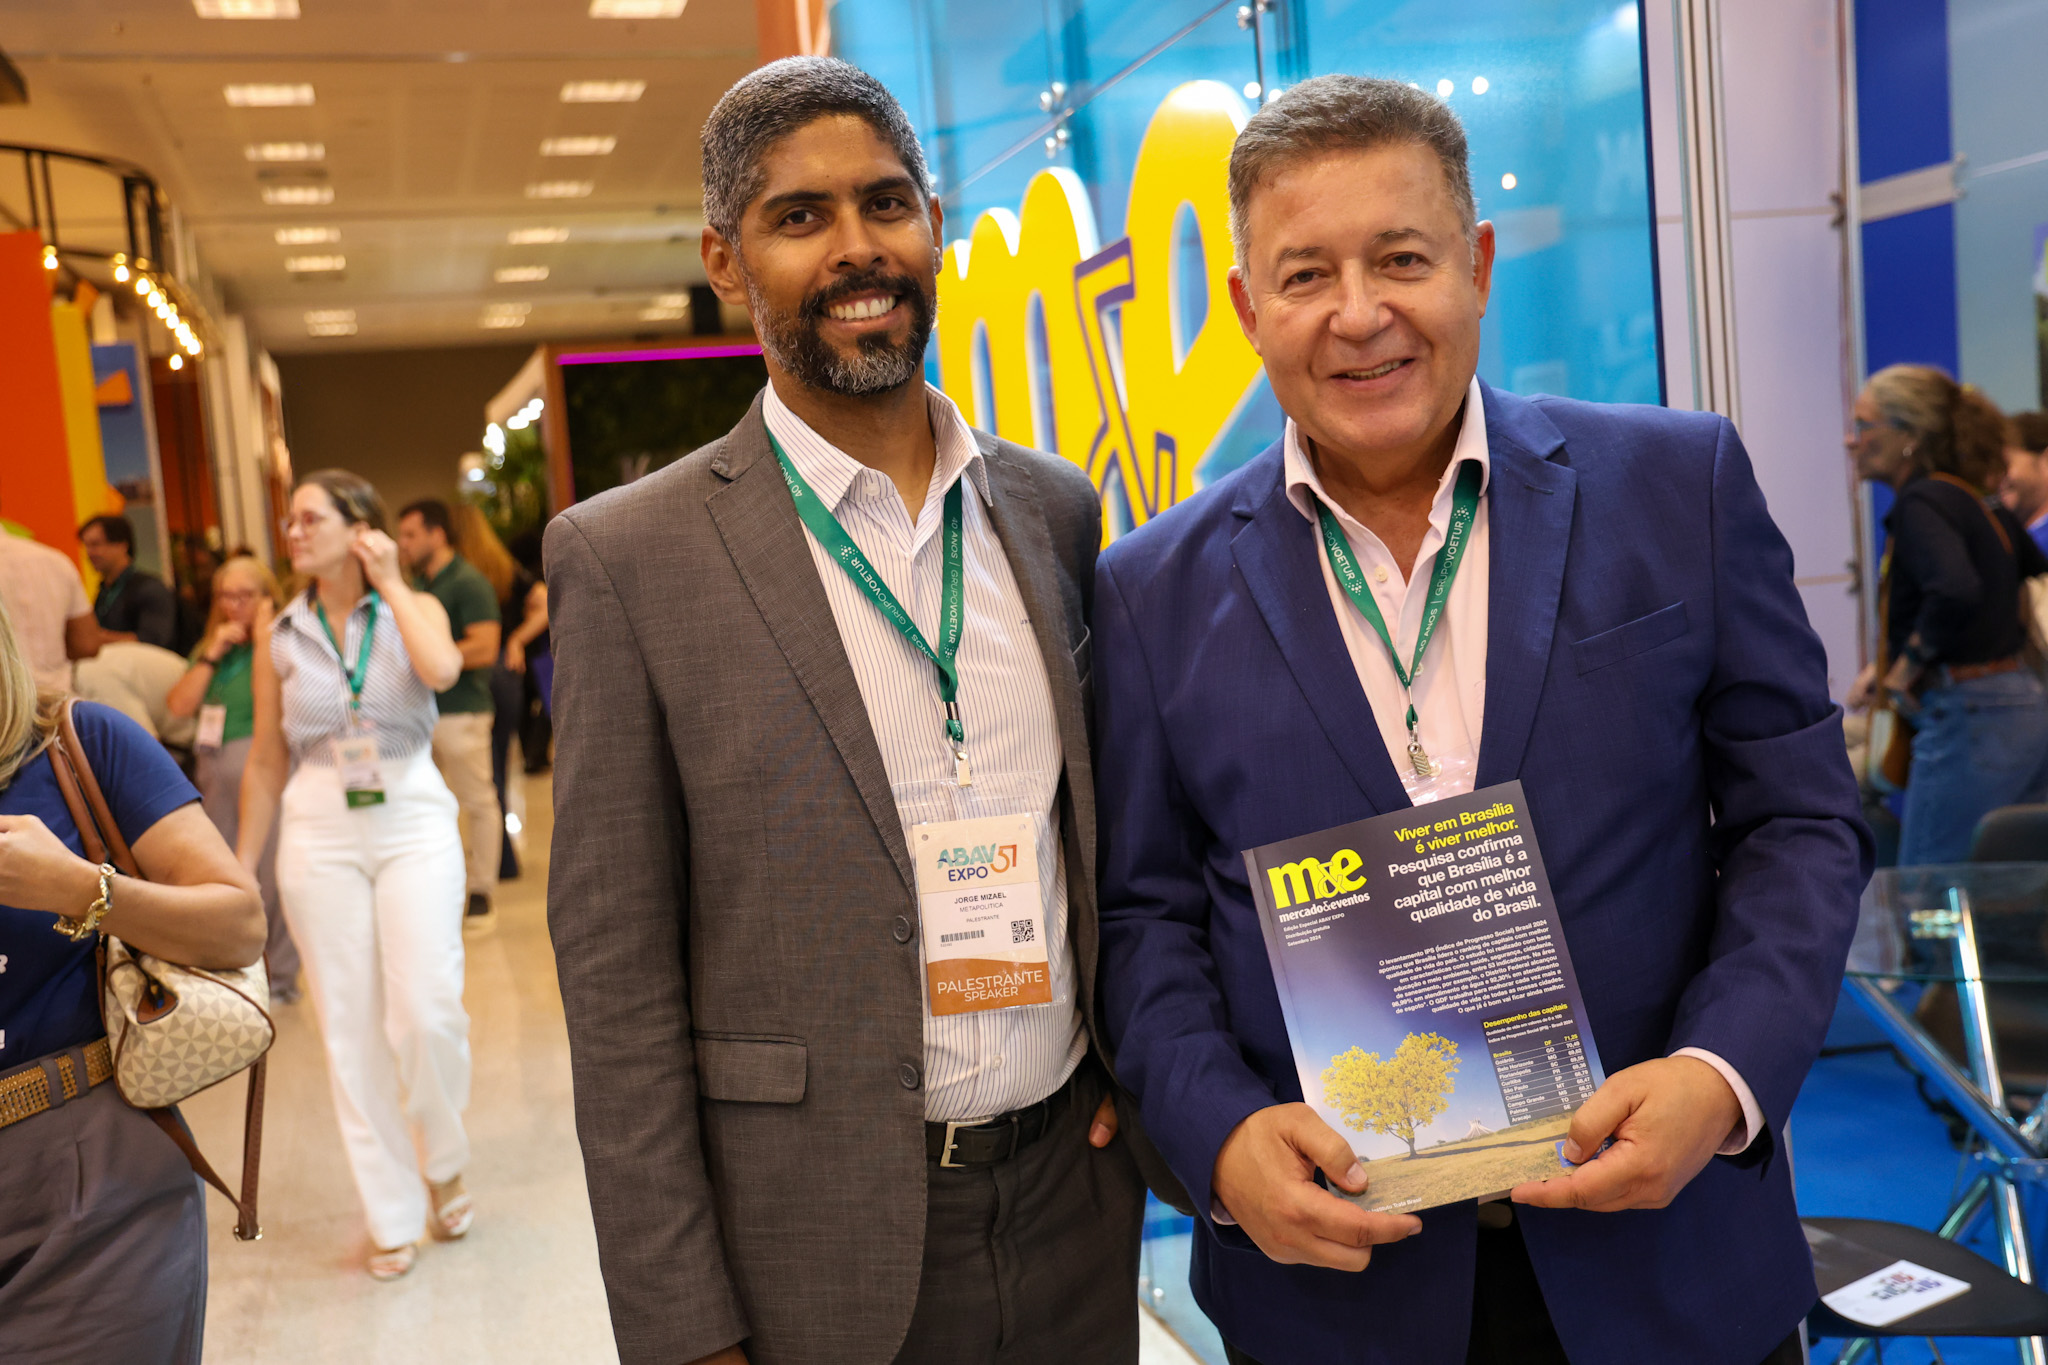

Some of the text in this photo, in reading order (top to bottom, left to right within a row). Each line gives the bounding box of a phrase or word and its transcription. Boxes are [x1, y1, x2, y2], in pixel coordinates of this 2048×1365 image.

[791, 484, 803, 497] 40
[851, 557, 906, 625] GRUPOVOETUR
[1419, 520, 1464, 652] 40 ANOS GRUPOVOETUR
[948, 570, 958, 644] GRUPOVOETUR
[1394, 803, 1514, 841] Viver em Brasília
[1415, 819, 1518, 853] é viver melhor.
[937, 843, 1017, 873] ABAV 51
[948, 866, 988, 882] EXPO
[1388, 835, 1522, 877] Pesquisa confirma
[1418, 849, 1527, 887] que Brasília é a
[1267, 849, 1367, 909] m&e
[1394, 865, 1530, 908] capital com melhor
[954, 892, 1007, 904] JORGE MIZAEL
[1279, 892, 1370, 922] mercado&eventos
[1410, 880, 1536, 922] qualidade de vida
[1472, 895, 1540, 922] do Brasil.
[966, 914, 999, 922] PALESTRANTE
[1378, 964, 1402, 973] apontou
[1414, 955, 1436, 964] Brasília
[1459, 944, 1481, 953] ranking
[1490, 936, 1513, 945] capitais
[1528, 927, 1548, 936] melhor
[1385, 951, 1423, 964] levantamento
[1435, 943, 1454, 952] (Índice
[1464, 934, 1493, 944] Progresso
[1494, 927, 1514, 936] Social)
[1515, 923, 1532, 931] Brasil
[1385, 968, 1413, 979] qualidade
[1444, 957, 1458, 965] país.
[1465, 950, 1485, 959] estudo
[1495, 941, 1521, 951] realizado
[1409, 966, 1451, 980] características
[1490, 949, 1522, 960] segurança,
[1523, 942, 1553, 952] cidadania,
[938, 970, 1043, 994] PALESTRANTE
[1393, 981, 1421, 992] educação
[1442, 970, 1471, 979] ambiente,
[1496, 954, 1531, 966] indicadores.
[1404, 984, 1441, 996] saneamento,
[1453, 975, 1479, 984] exemplo,
[1485, 968, 1506, 976] Distrito
[1507, 961, 1529, 971] Federal
[1530, 955, 1557, 965] alcançou
[1424, 987, 1460, 999] atendimento
[1523, 962, 1559, 974] atendimento
[1448, 991, 1472, 1000] trabalha
[1488, 981, 1513, 990] melhorar
[1543, 984, 1565, 992] melhor.
[964, 986, 1018, 1002] SPEAKER
[1431, 1002, 1459, 1012] qualidade
[1516, 983, 1537, 991] nossas
[1538, 977, 1562, 986] cidades.
[1483, 1013, 1527, 1028] Desempenho
[1541, 1003, 1567, 1014] capitais
